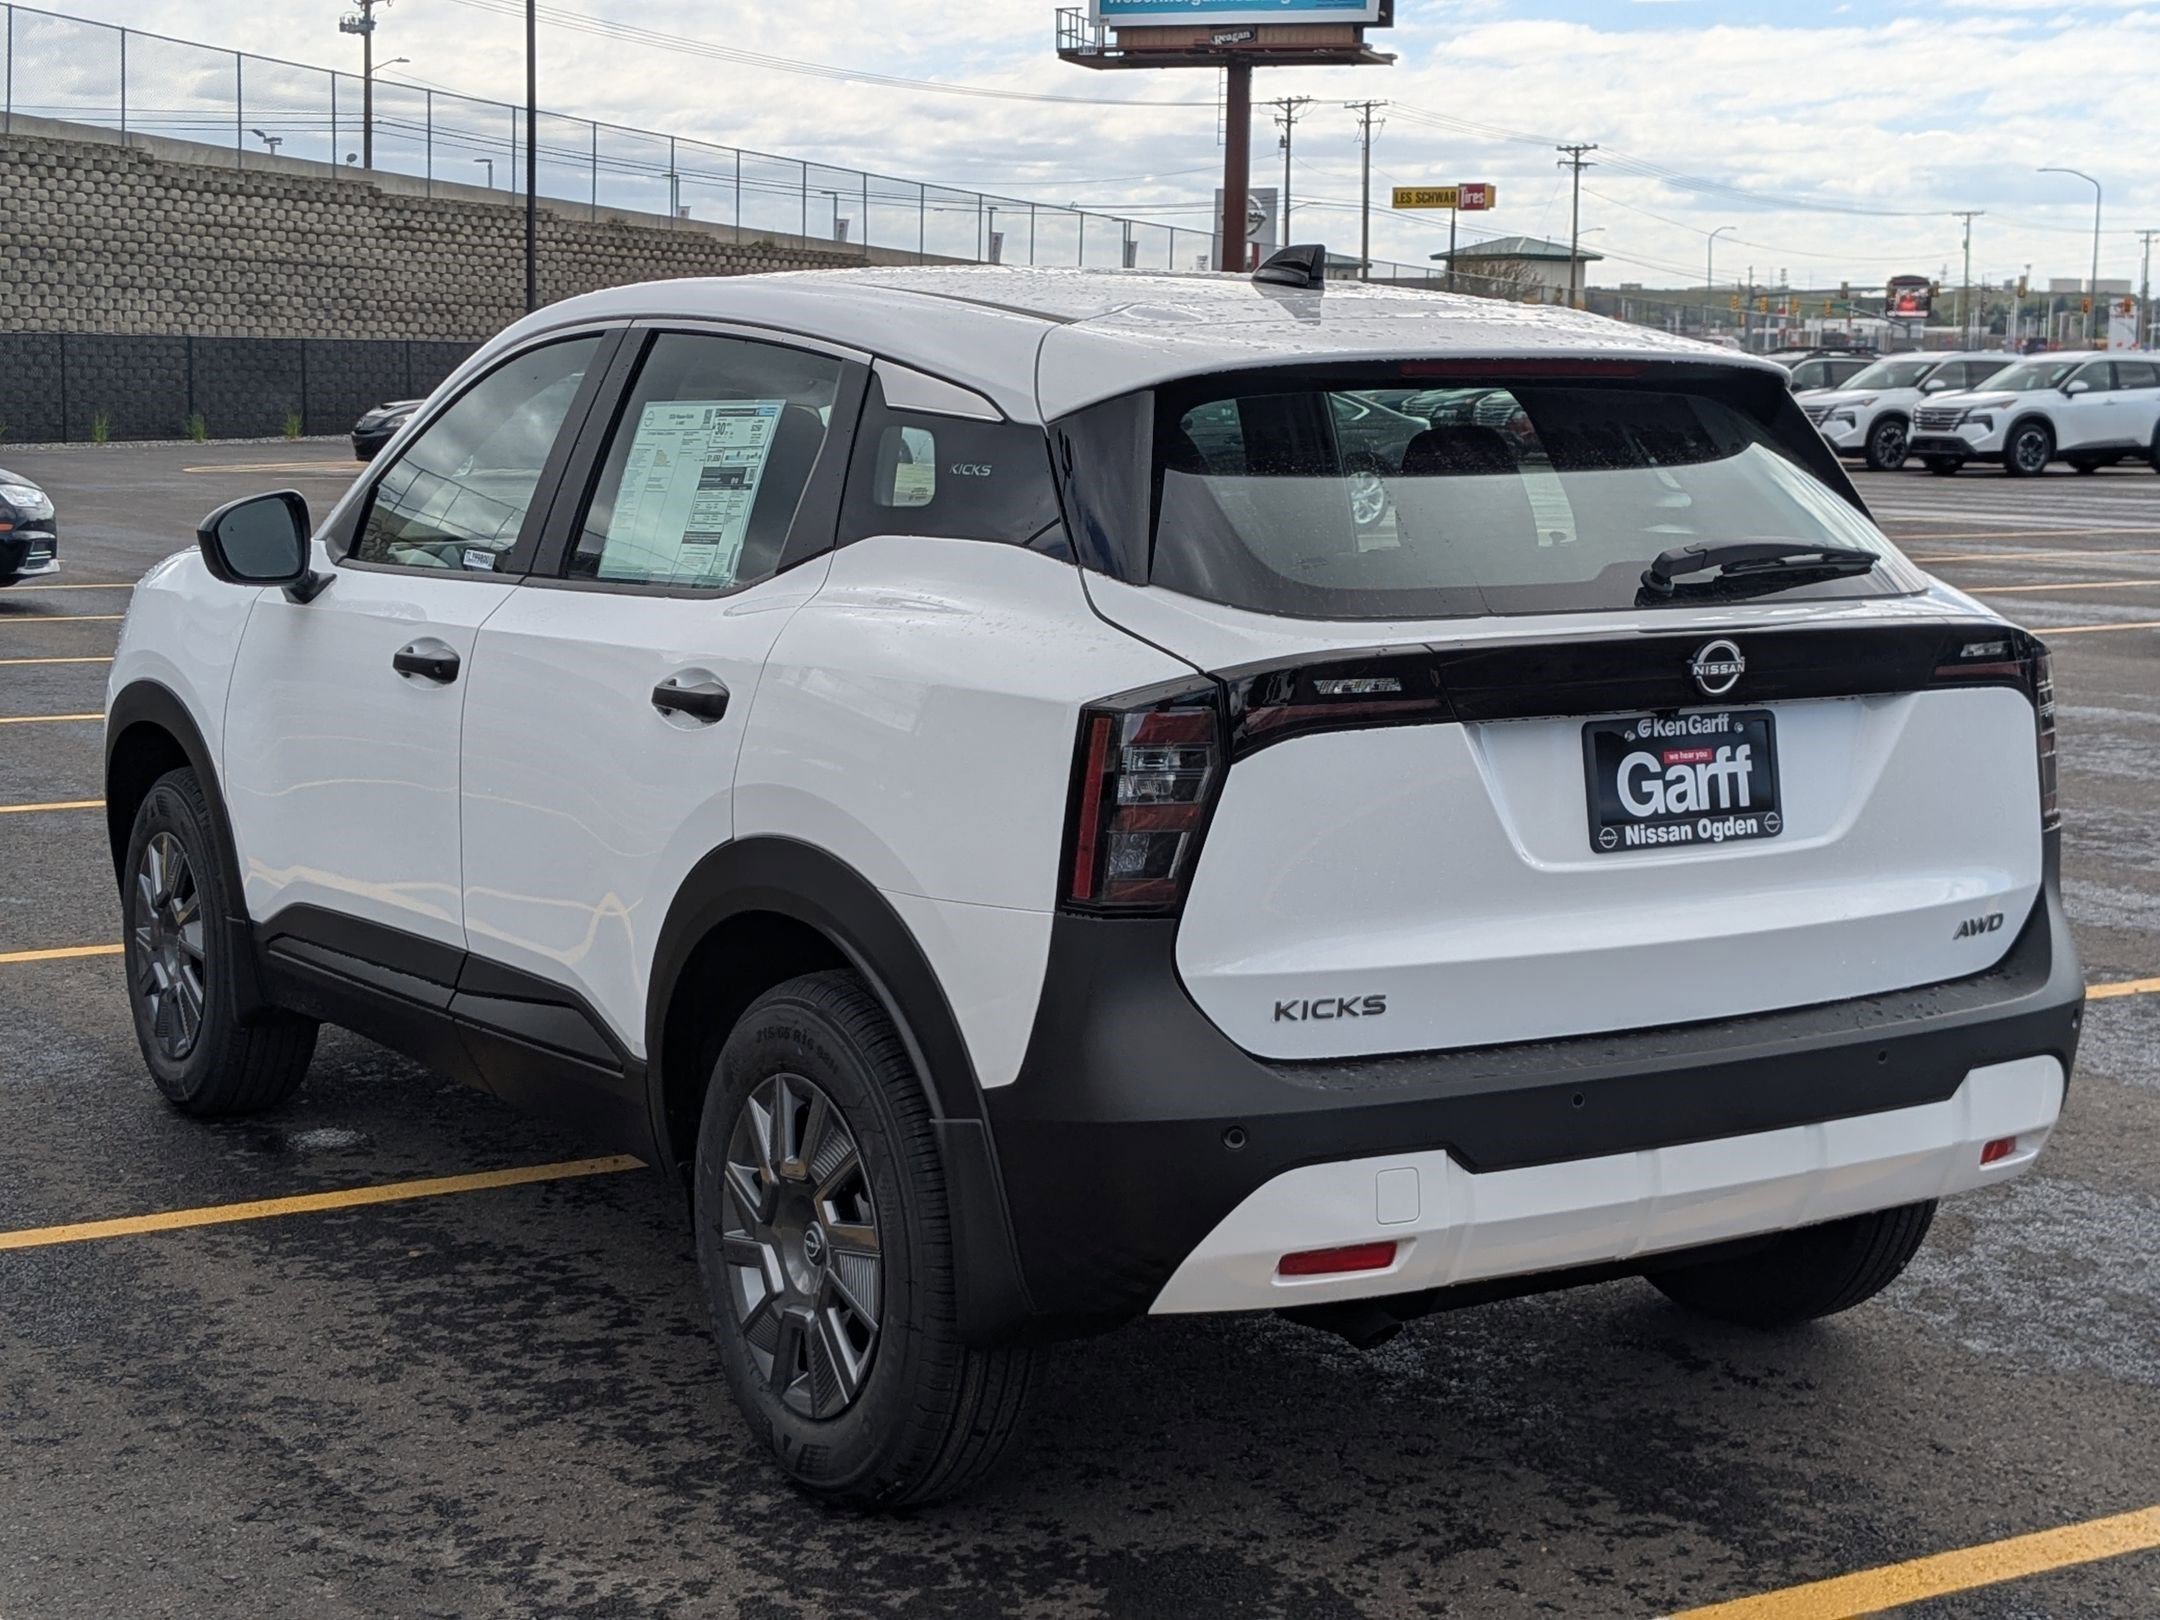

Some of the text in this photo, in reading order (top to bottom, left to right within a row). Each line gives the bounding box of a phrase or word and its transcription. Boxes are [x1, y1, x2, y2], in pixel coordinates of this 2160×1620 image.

[1213, 31, 1251, 46] Reagan
[1395, 186, 1485, 208] LES SCHWAB Tires
[949, 463, 992, 476] KICKS
[1693, 663, 1745, 675] NISSAN
[1616, 744, 1753, 817] Garff
[1624, 816, 1758, 846] Nissan Ogden
[1952, 912, 2004, 940] AWD
[1274, 994, 1387, 1021] KICKS
